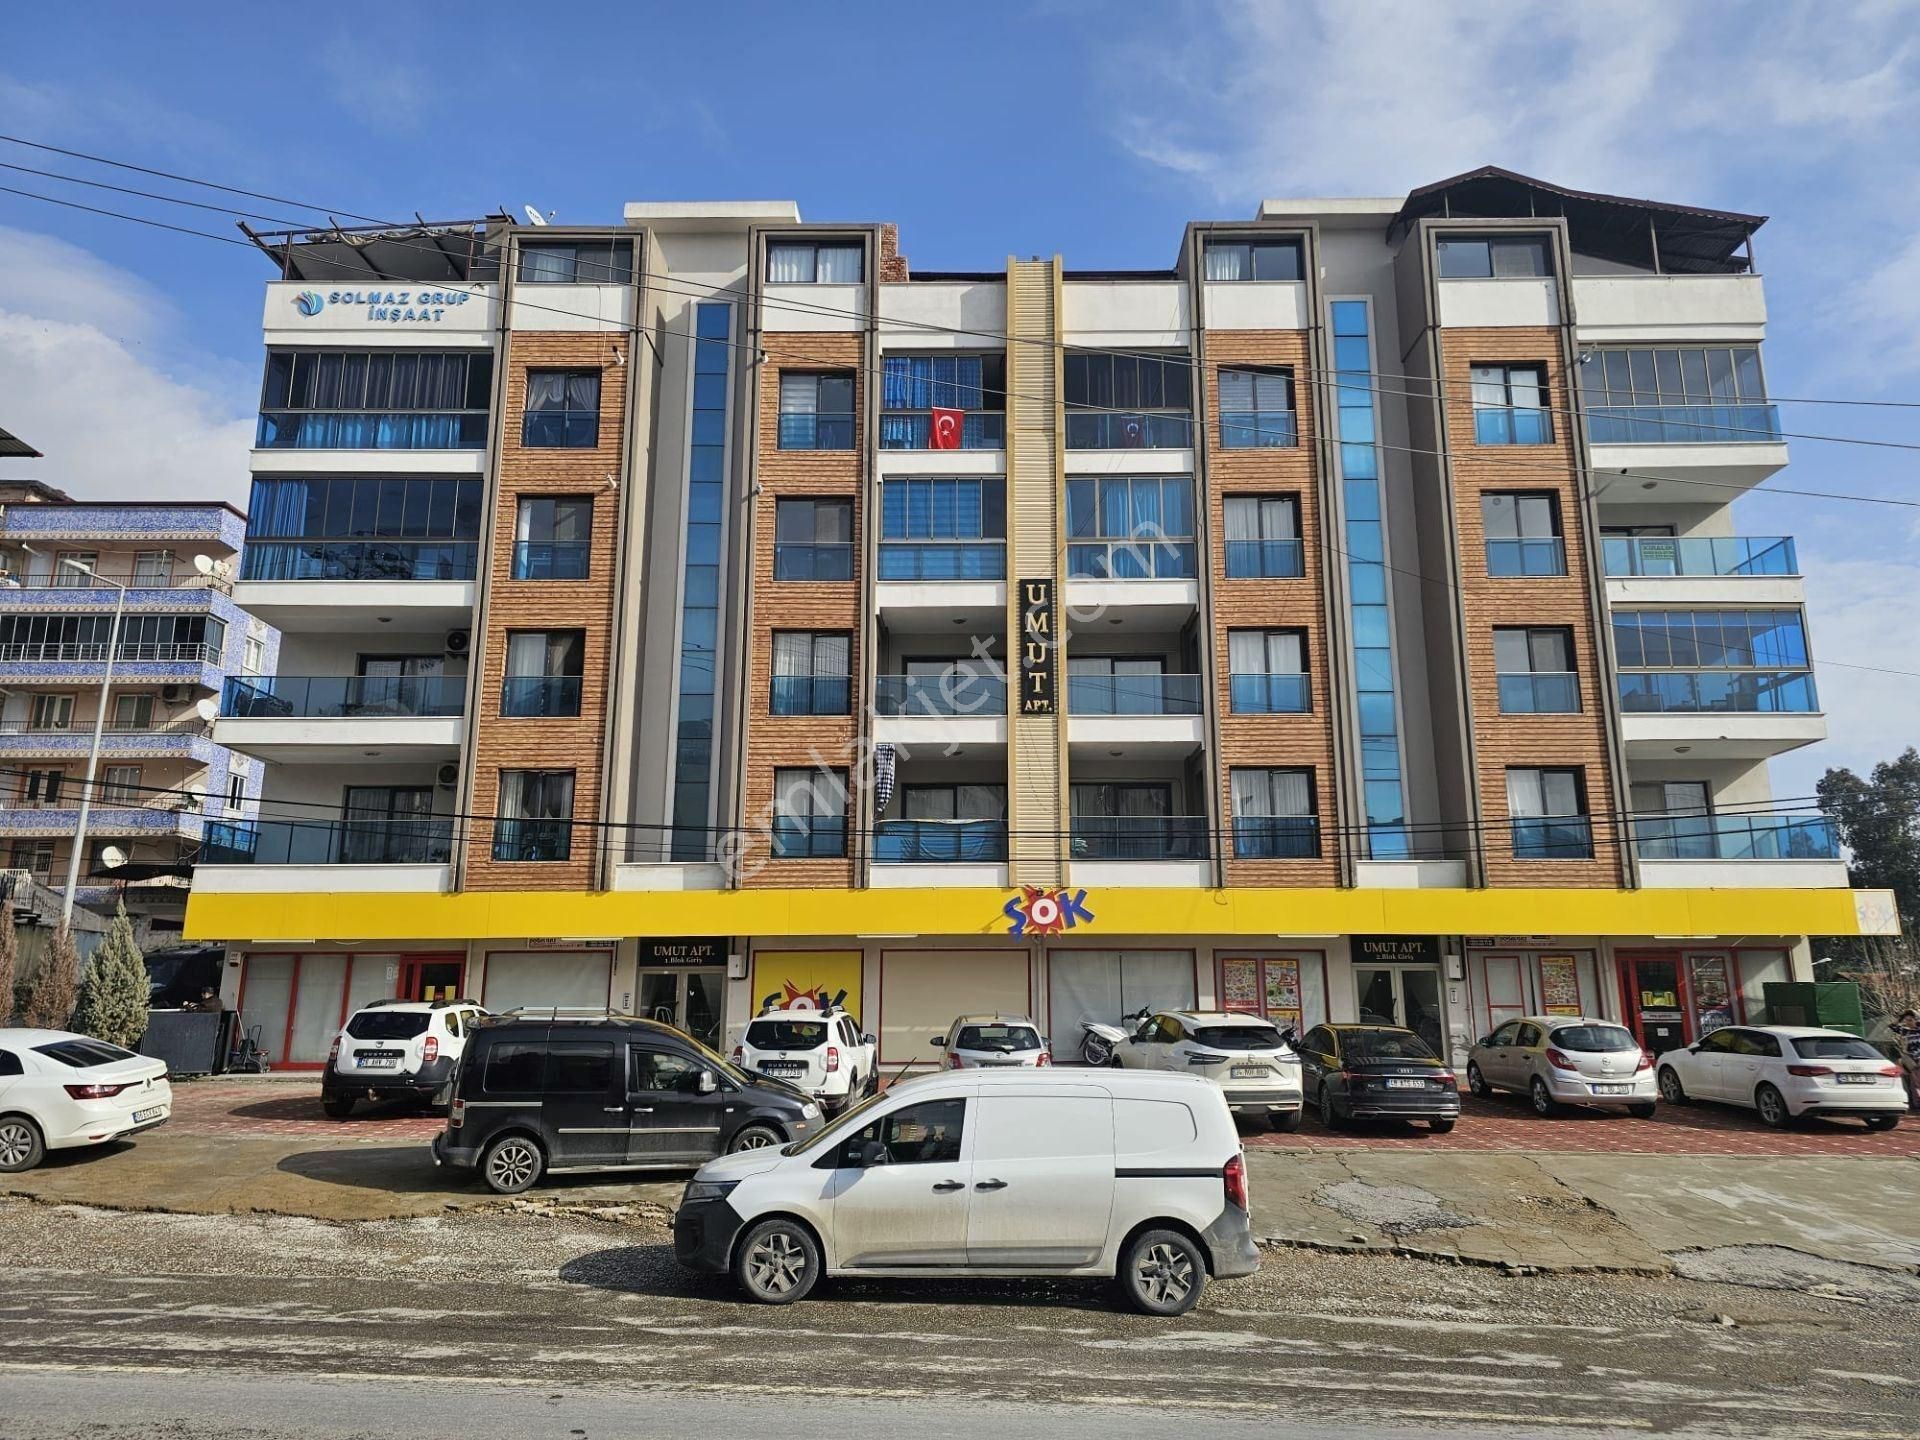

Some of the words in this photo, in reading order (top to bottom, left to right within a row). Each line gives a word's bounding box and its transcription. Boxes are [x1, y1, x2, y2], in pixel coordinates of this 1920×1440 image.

[328, 291, 410, 306] SOLMAZ
[417, 291, 470, 306] GRUP
[367, 305, 445, 323] İNŞAAT
[1025, 584, 1049, 694] UMUT
[1025, 699, 1053, 713] APT.
[1003, 888, 1096, 944] ŞOK
[653, 945, 688, 956] UMUT
[690, 945, 716, 956] APT.
[1363, 942, 1398, 953] UMUT
[1400, 942, 1426, 953] APT.
